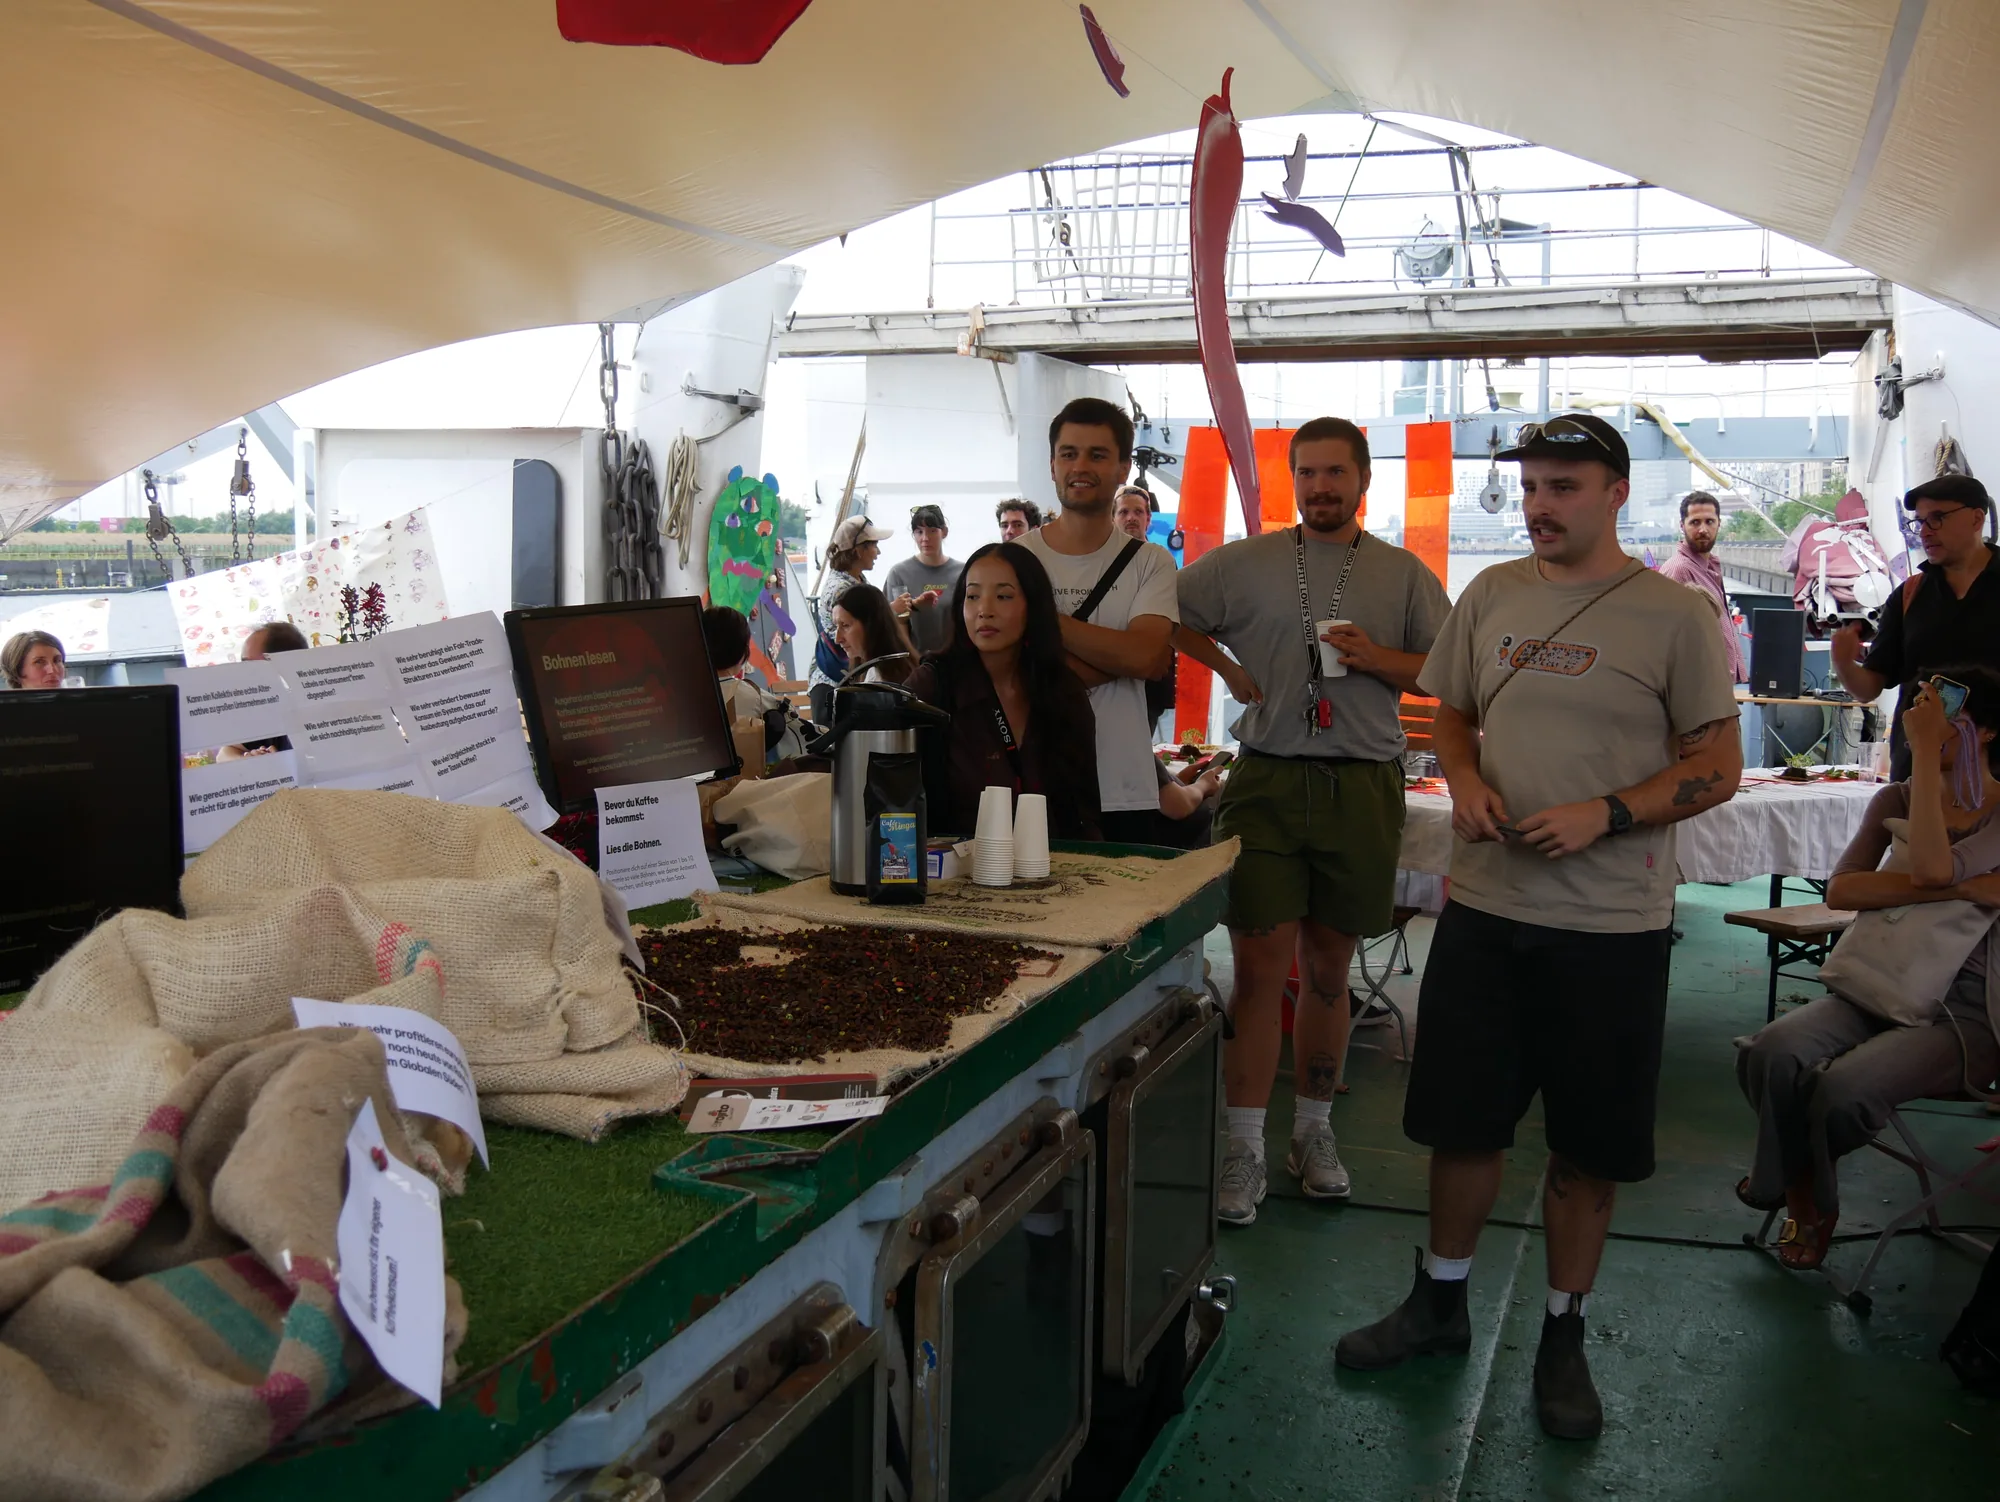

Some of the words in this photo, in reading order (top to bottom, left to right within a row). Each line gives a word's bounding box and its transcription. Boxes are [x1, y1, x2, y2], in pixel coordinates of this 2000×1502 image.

[1296, 547, 1306, 585] GRAFFITI
[1054, 588, 1068, 596] IVE
[1335, 568, 1349, 595] LOVES
[1300, 588, 1310, 617] LOVES
[1304, 619, 1314, 642] YOU!
[396, 656, 406, 664] Wie
[406, 654, 418, 662] sehr
[418, 648, 444, 659] beruhigt
[453, 638, 484, 650] Fair-Trade-
[399, 666, 414, 674] Label
[414, 663, 427, 672] eher
[427, 660, 439, 668] das
[438, 653, 470, 665] Gewissen,
[469, 648, 484, 656] statt
[542, 652, 586, 671] Bohnen
[586, 650, 616, 666] lesen
[296, 670, 308, 678] Wie
[307, 668, 317, 676] viel
[316, 664, 352, 675] Verantwortung
[351, 662, 361, 670] wird
[361, 660, 374, 669] durch
[403, 672, 434, 684] Strukturen
[440, 660, 474, 676] verändern?
[186, 695, 203, 704] Kann
[202, 693, 212, 702] ein
[211, 689, 233, 700] Kollektiv
[233, 688, 244, 697] eine
[244, 686, 258, 695] echte
[258, 684, 272, 694] Alter-
[301, 680, 319, 689] Labels
[306, 688, 336, 701] abgegeben?
[189, 706, 210, 717] native
[209, 706, 216, 714] zu
[216, 702, 234, 714] großen
[234, 698, 268, 710] Unternehmen
[410, 704, 420, 712] Wie
[420, 702, 432, 710] sehr
[432, 695, 459, 708] verändert
[459, 688, 492, 700] bewusster
[414, 712, 434, 722] Konsum
[434, 710, 442, 718] ein
[442, 705, 464, 716] System,
[464, 702, 476, 710] das
[475, 698, 486, 708] auf
[304, 723, 317, 731] Wie
[316, 720, 330, 730] sehr
[330, 716, 354, 727] vertraust
[420, 719, 450, 731] Ausbeutung
[448, 712, 477, 725] aufgebaut
[476, 706, 498, 718] wurde?
[309, 734, 319, 742] sie
[318, 731, 330, 740] sich
[330, 728, 358, 739] nachhaltig
[431, 759, 442, 767] Wie
[440, 754, 450, 764] viel
[448, 745, 476, 761] Ungleichheit
[475, 738, 490, 750] steckt
[490, 736, 497, 744] in
[437, 768, 450, 777] einer
[448, 762, 462, 772] Tasse
[460, 754, 478, 767] Kaffee?
[188, 794, 202, 804] Wie
[203, 788, 230, 802] gerecht
[230, 786, 239, 795] ist
[238, 782, 256, 793] fairer
[256, 778, 280, 790] Konsum,
[280, 775, 294, 784] wenn
[198, 804, 216, 815] nicht
[216, 802, 227, 811] für
[227, 799, 240, 808] alle
[240, 795, 259, 808] gleich
[604, 800, 626, 811] Bevor
[626, 798, 635, 808] du
[634, 796, 660, 806] Kaffee
[605, 812, 645, 826] bekommst:
[881, 819, 896, 828] Café
[888, 822, 916, 832] Minga
[606, 844, 622, 855] Lies
[622, 842, 634, 852] die
[634, 838, 662, 850] Bohnen.
[606, 866, 631, 876] Positioniere
[630, 864, 641, 872] dich
[640, 862, 648, 870] auf
[658, 859, 670, 867] Skala
[670, 858, 678, 866] von
[680, 856, 688, 864] bis
[640, 870, 657, 879] Bohnen,
[666, 866, 680, 874] deiner
[680, 864, 698, 872] Antwort
[644, 879, 654, 888] lege
[394, 1029, 444, 1051] profitieren
[388, 1042, 416, 1056] noch
[415, 1046, 442, 1065] heute
[398, 1058, 443, 1079] Globalen
[372, 1197, 384, 1235] eigener
[384, 1255, 398, 1337] Kaffeekonsum?
